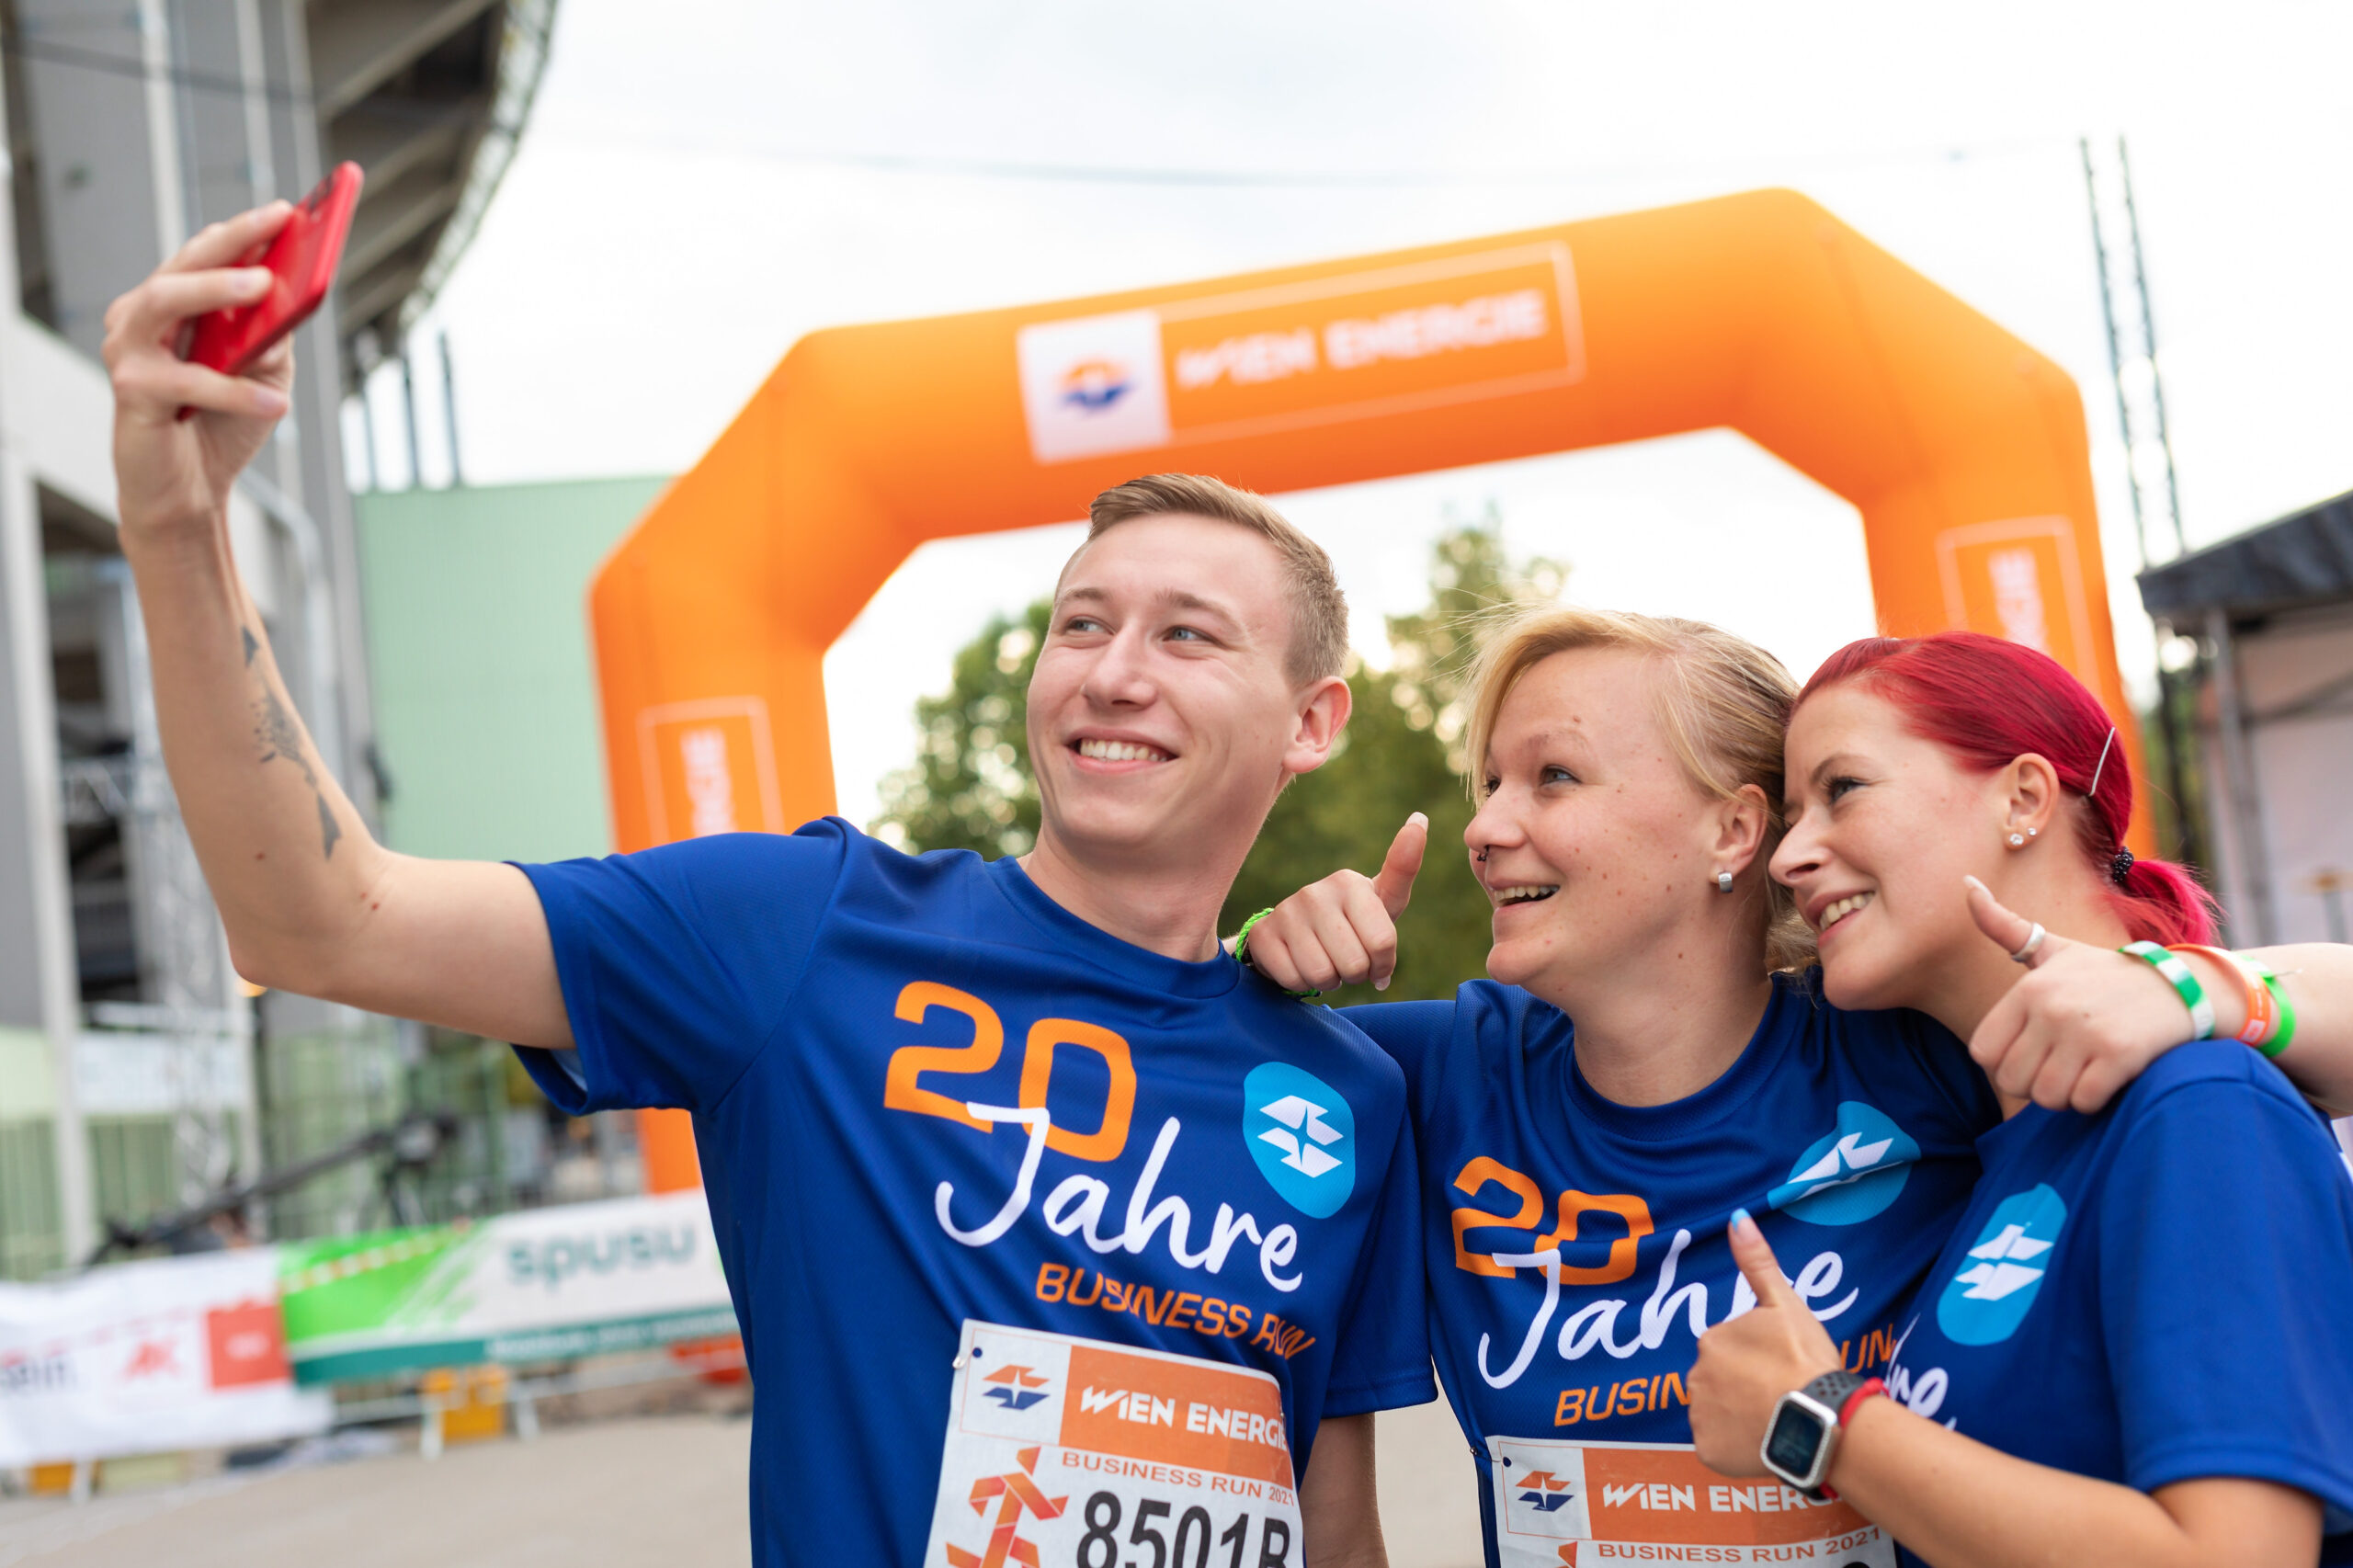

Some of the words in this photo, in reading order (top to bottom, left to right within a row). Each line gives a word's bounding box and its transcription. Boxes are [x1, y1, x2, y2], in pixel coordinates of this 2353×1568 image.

[1176, 327, 1316, 391] WIEN
[1324, 288, 1549, 369] ENERGIE
[884, 981, 1137, 1162] 20
[935, 1101, 1302, 1292] Jahre
[1452, 1156, 1654, 1285] 20
[506, 1222, 696, 1292] spusu
[1036, 1262, 1252, 1338] BUSINESS
[1250, 1312, 1315, 1360] RUN
[1080, 1385, 1176, 1428] WIEN
[1186, 1402, 1287, 1451] ENERGIE
[1554, 1372, 1691, 1426] BUSIN
[1840, 1323, 1897, 1374] UN
[1062, 1451, 1202, 1488] BUSINESS
[1211, 1475, 1263, 1498] RUN
[1268, 1485, 1294, 1506] 2021
[1602, 1483, 1696, 1512] WIEN
[1708, 1485, 1833, 1513] ENER
[1597, 1543, 1742, 1562] BUSINESS
[1752, 1544, 1815, 1562] RUN
[1824, 1527, 1881, 1555] 2021
